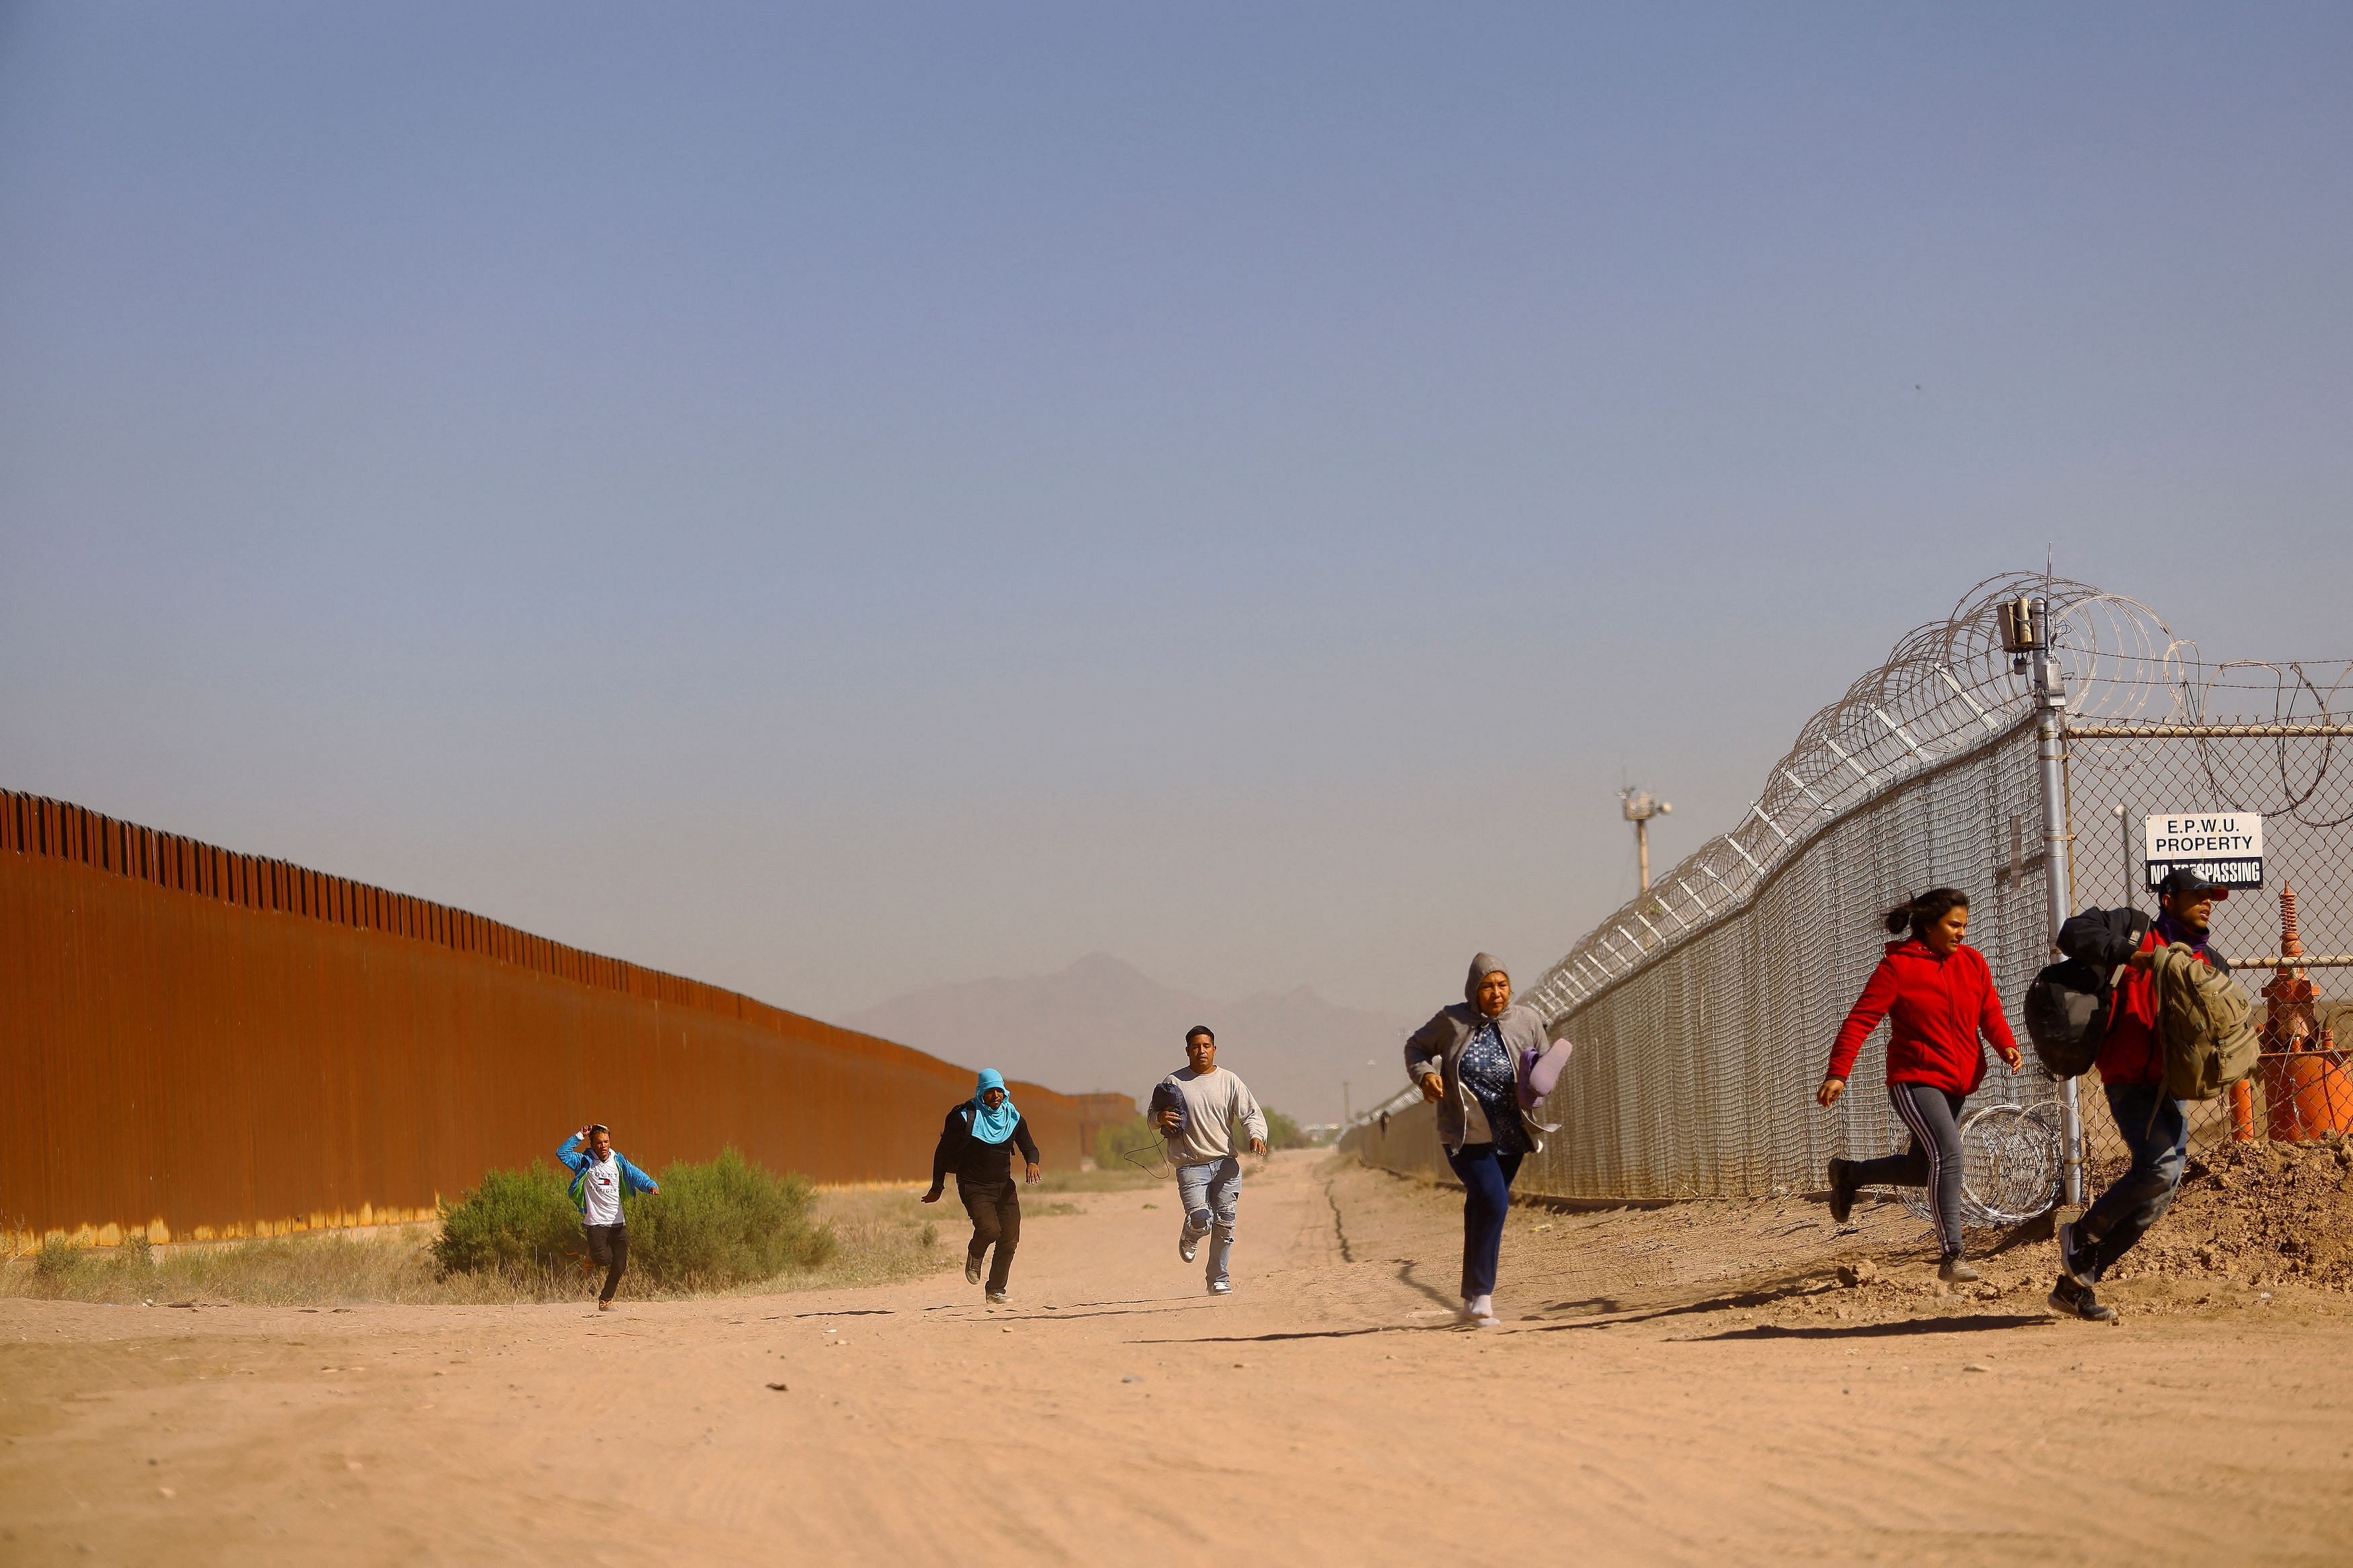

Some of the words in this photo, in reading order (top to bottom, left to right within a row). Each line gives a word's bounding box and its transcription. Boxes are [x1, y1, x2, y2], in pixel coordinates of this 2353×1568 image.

[2167, 819, 2239, 833] E.P.W.U.
[2156, 836, 2252, 852] PROPERTY
[2151, 865, 2168, 884] NO
[2173, 862, 2260, 882] PASSING
